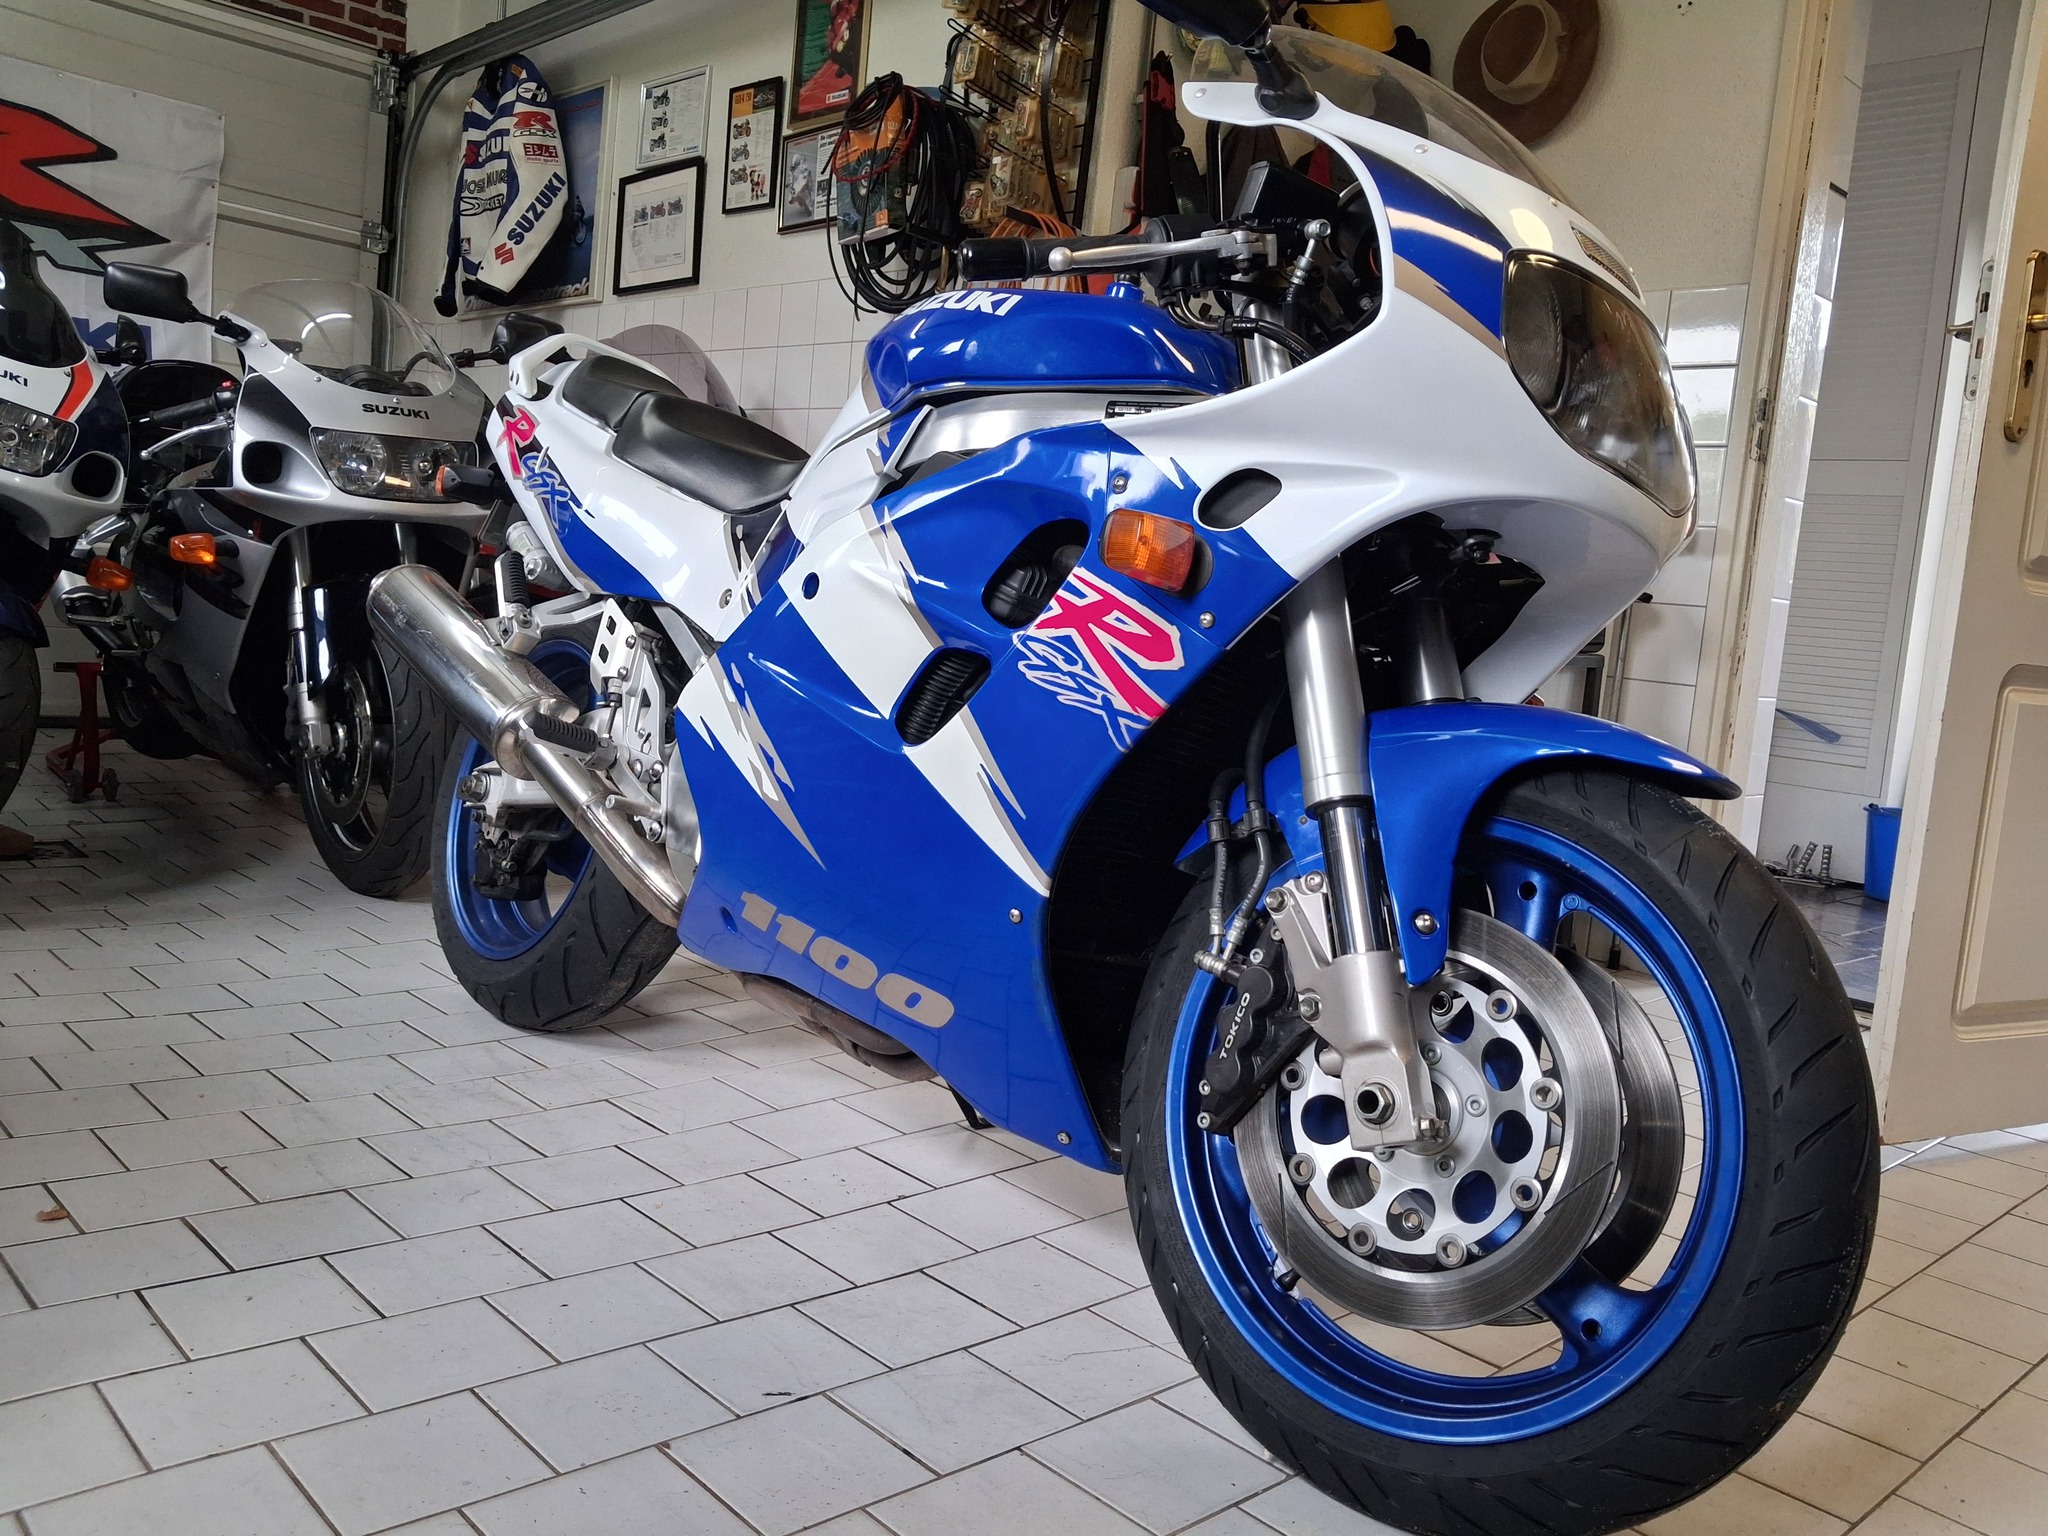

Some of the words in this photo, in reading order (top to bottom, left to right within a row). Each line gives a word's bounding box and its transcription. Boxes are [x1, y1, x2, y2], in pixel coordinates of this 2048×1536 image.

[525, 144, 556, 157] ヨシムラ
[507, 171, 566, 246] SUZUKI
[361, 403, 430, 420] SUZUKI
[740, 891, 955, 1028] 1100
[1219, 992, 1251, 1060] TOKICO
